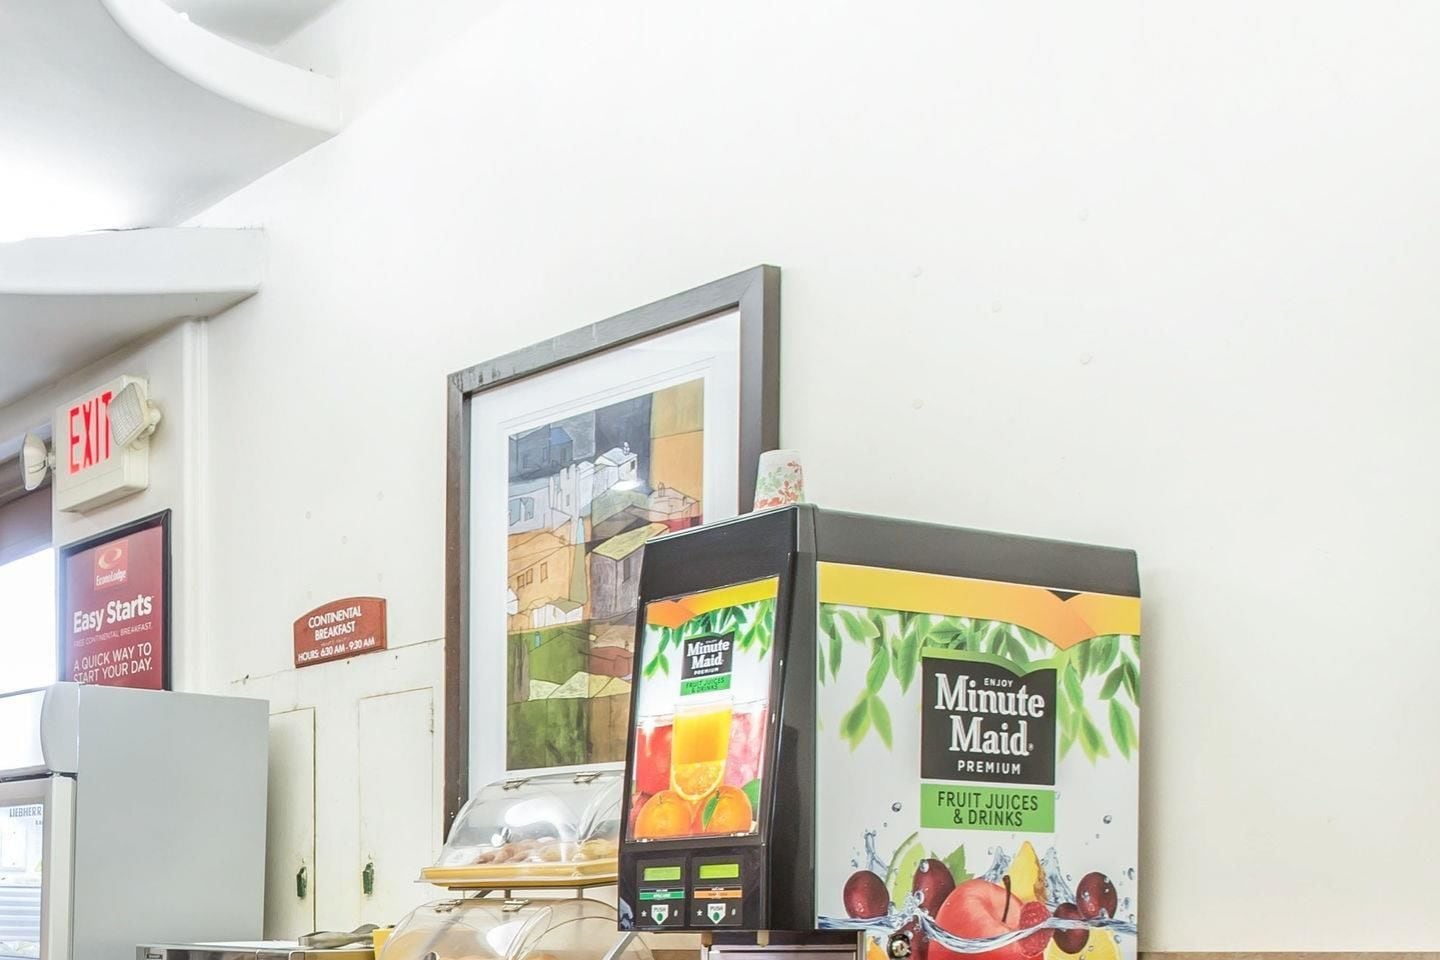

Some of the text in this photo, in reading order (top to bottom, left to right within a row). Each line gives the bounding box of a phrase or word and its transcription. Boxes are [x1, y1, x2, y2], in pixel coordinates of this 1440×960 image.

[68, 391, 112, 474] EXIT
[73, 594, 152, 634] Easy Starts
[308, 606, 362, 629] CONTINENTAL
[315, 621, 356, 641] BREAKFAST
[334, 643, 346, 654] AM
[363, 636, 376, 648] AM
[687, 639, 730, 657] Minute
[73, 642, 152, 672] A QUICK WAY TO
[691, 651, 723, 669] Maid
[73, 656, 153, 684] START YOUR DAY.
[984, 677, 1014, 688] ENJOY
[934, 673, 1045, 718] Minute
[949, 715, 1031, 757] Maid
[958, 759, 1021, 775] PREMIUM
[938, 790, 1038, 811] FRUIT JUICES
[10, 806, 42, 817] LIEBHERR
[953, 808, 1023, 827] & DRINKS
